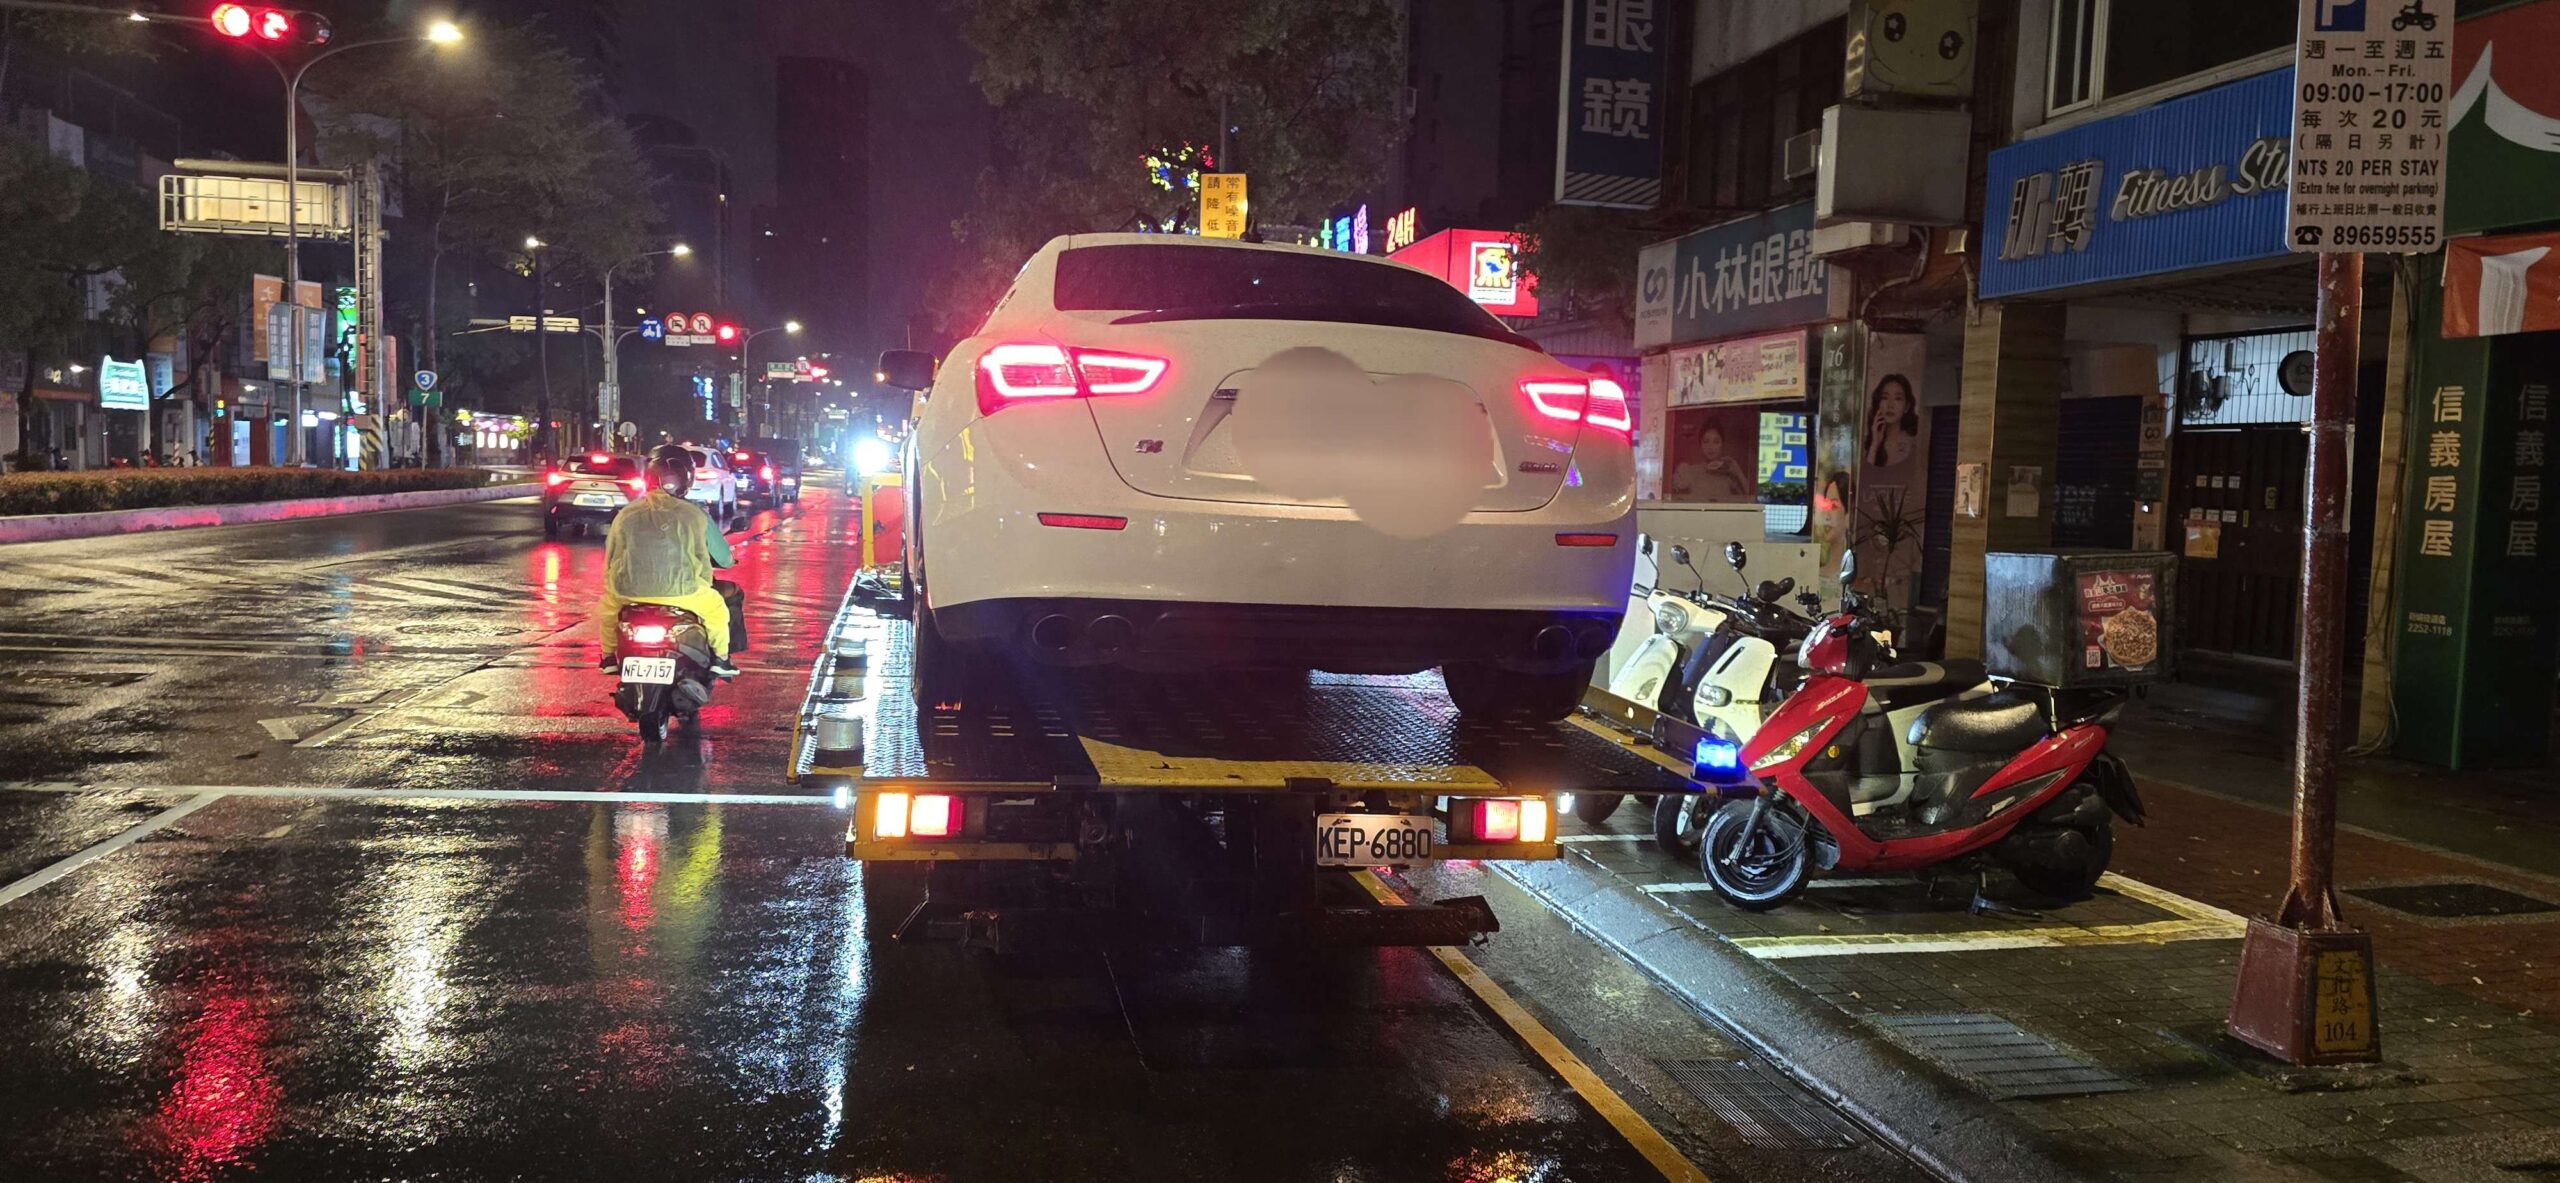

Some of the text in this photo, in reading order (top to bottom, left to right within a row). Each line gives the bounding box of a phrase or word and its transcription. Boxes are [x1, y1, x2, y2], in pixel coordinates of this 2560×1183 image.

[2304, 39, 2445, 60] 週一至週五
[1582, 0, 1654, 139] 眼鏡
[2302, 83, 2444, 103] 09:00-17:00
[2299, 133, 2441, 150] (隔日另計)
[2111, 138, 2290, 219] Fitness Stu
[2297, 159, 2439, 177] NT$ 20 PER STAY
[2297, 182, 2439, 197] (Extra fee for overnight parking)
[1206, 176, 1221, 231] 請降低
[1386, 207, 1416, 253] 24H
[2333, 225, 2436, 245] 89659555
[1677, 229, 1825, 320] 小林眼鏡
[421, 374, 431, 385] 3
[420, 392, 430, 404] 7
[2420, 385, 2465, 557] 信義房屋
[2506, 384, 2549, 557] 信義房屋
[2324, 1021, 2358, 1043] 104
